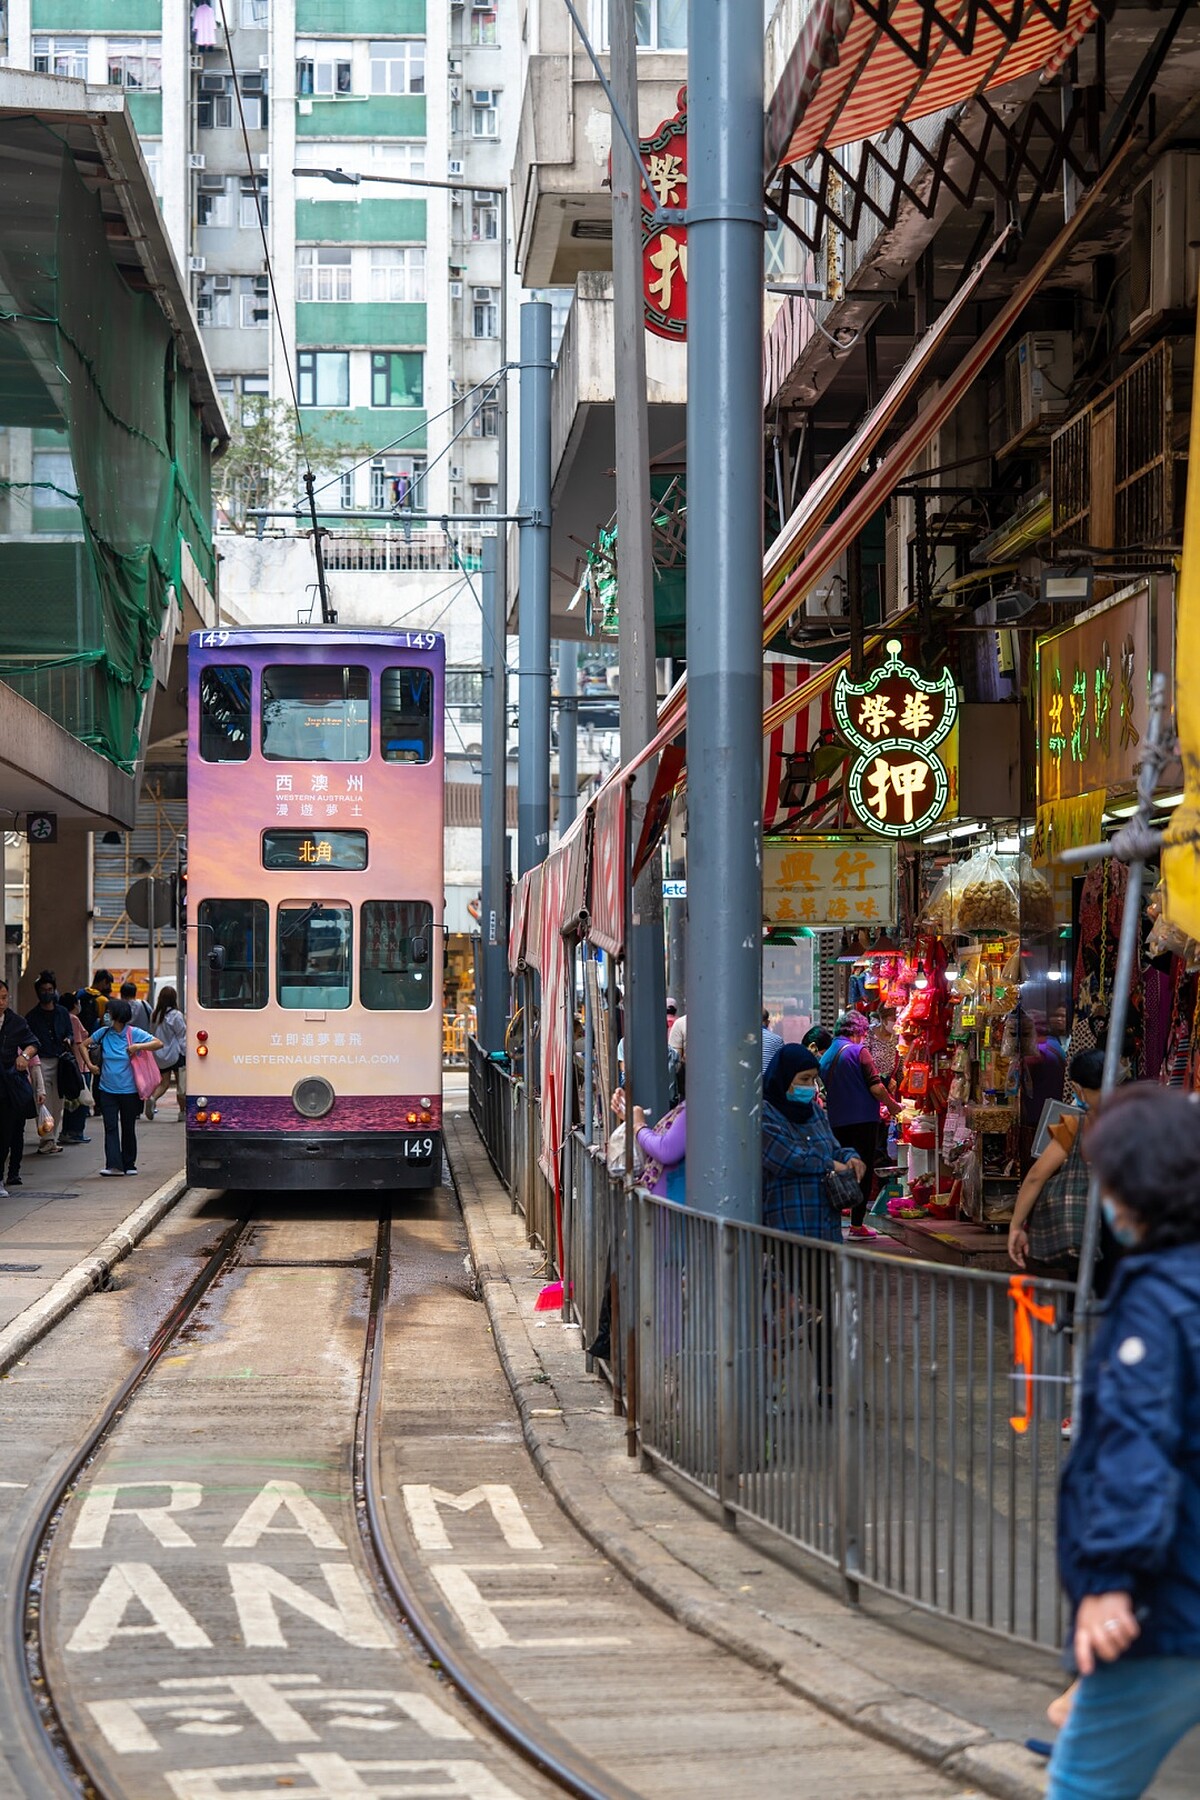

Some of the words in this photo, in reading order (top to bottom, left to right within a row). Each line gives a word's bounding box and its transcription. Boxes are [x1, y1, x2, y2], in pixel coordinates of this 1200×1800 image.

[199, 630, 230, 648] 149
[406, 633, 436, 650] 149
[858, 691, 934, 739] 榮華
[276, 774, 363, 792] 西澳州
[867, 757, 929, 823] 押
[276, 803, 363, 817] 漫遊夢土
[299, 841, 332, 862] 北角
[233, 1055, 400, 1065] WESTERNAUSTRALIA.COM
[404, 1139, 433, 1157] 149
